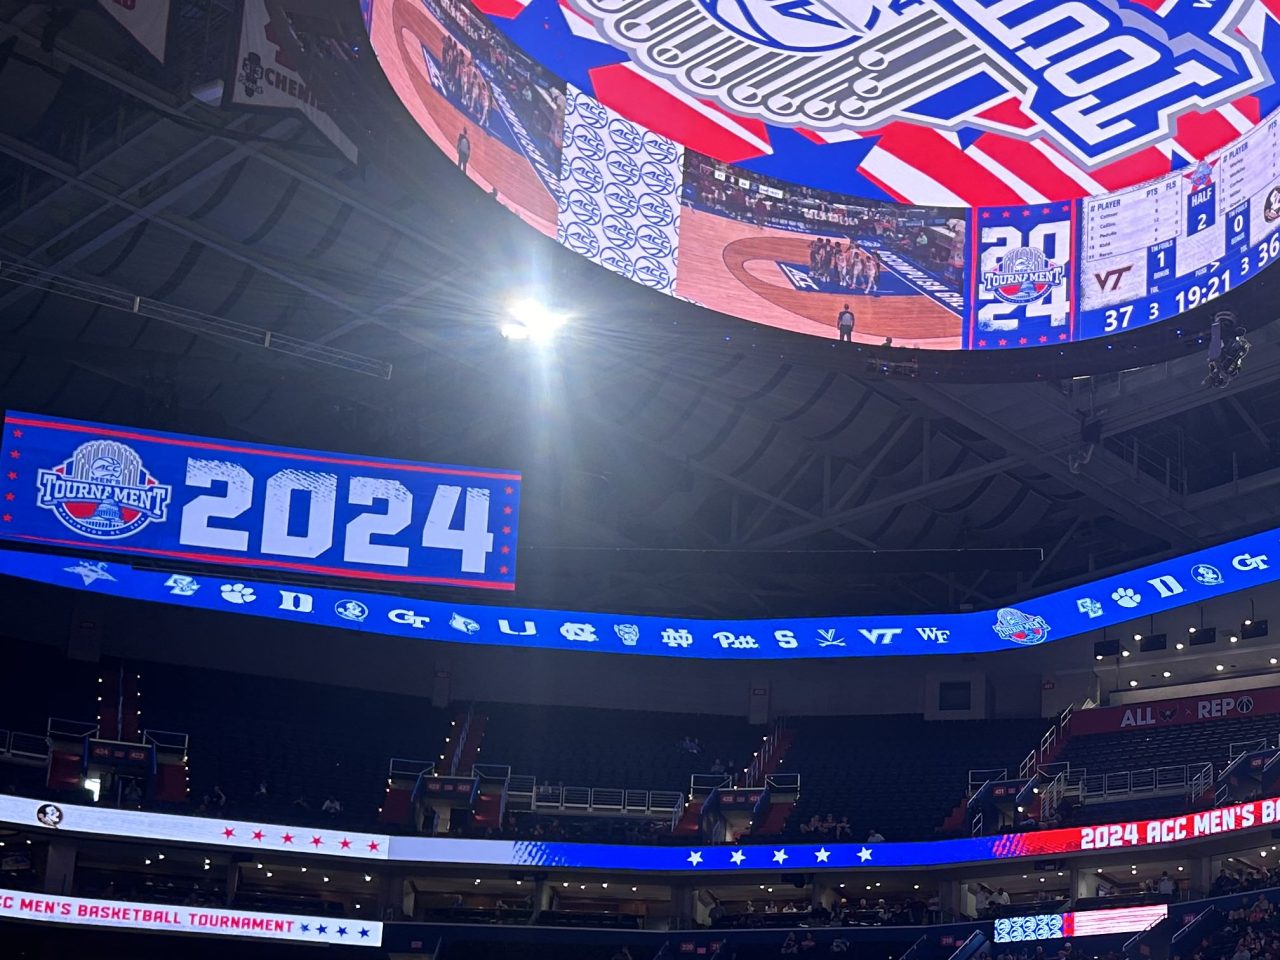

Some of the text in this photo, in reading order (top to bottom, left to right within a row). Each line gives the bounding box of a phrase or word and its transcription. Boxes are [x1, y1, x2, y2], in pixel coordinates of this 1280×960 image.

[1191, 190, 1212, 208] HALF
[1198, 214, 1207, 230] 2
[1233, 220, 1244, 232] 0
[1157, 252, 1165, 267] 1
[1258, 233, 1280, 267] 36
[1094, 264, 1134, 291] VT
[1240, 257, 1249, 276] 3
[1175, 270, 1231, 314] 19:21
[1104, 306, 1134, 332] 37
[1148, 303, 1159, 320] 3
[43, 474, 166, 515] TOURNAMENT
[180, 457, 494, 573] 2024
[713, 631, 759, 649] Pitt
[857, 628, 903, 644] VT
[1120, 699, 1234, 726] ALL REP
[1081, 822, 1137, 850] 2024
[1146, 817, 1187, 844] ACC
[1194, 801, 1255, 837] MEN'S
[20, 898, 71, 915] MEN'S
[78, 904, 181, 925] BASKETBALL
[188, 913, 294, 933] TOURNAMENT
